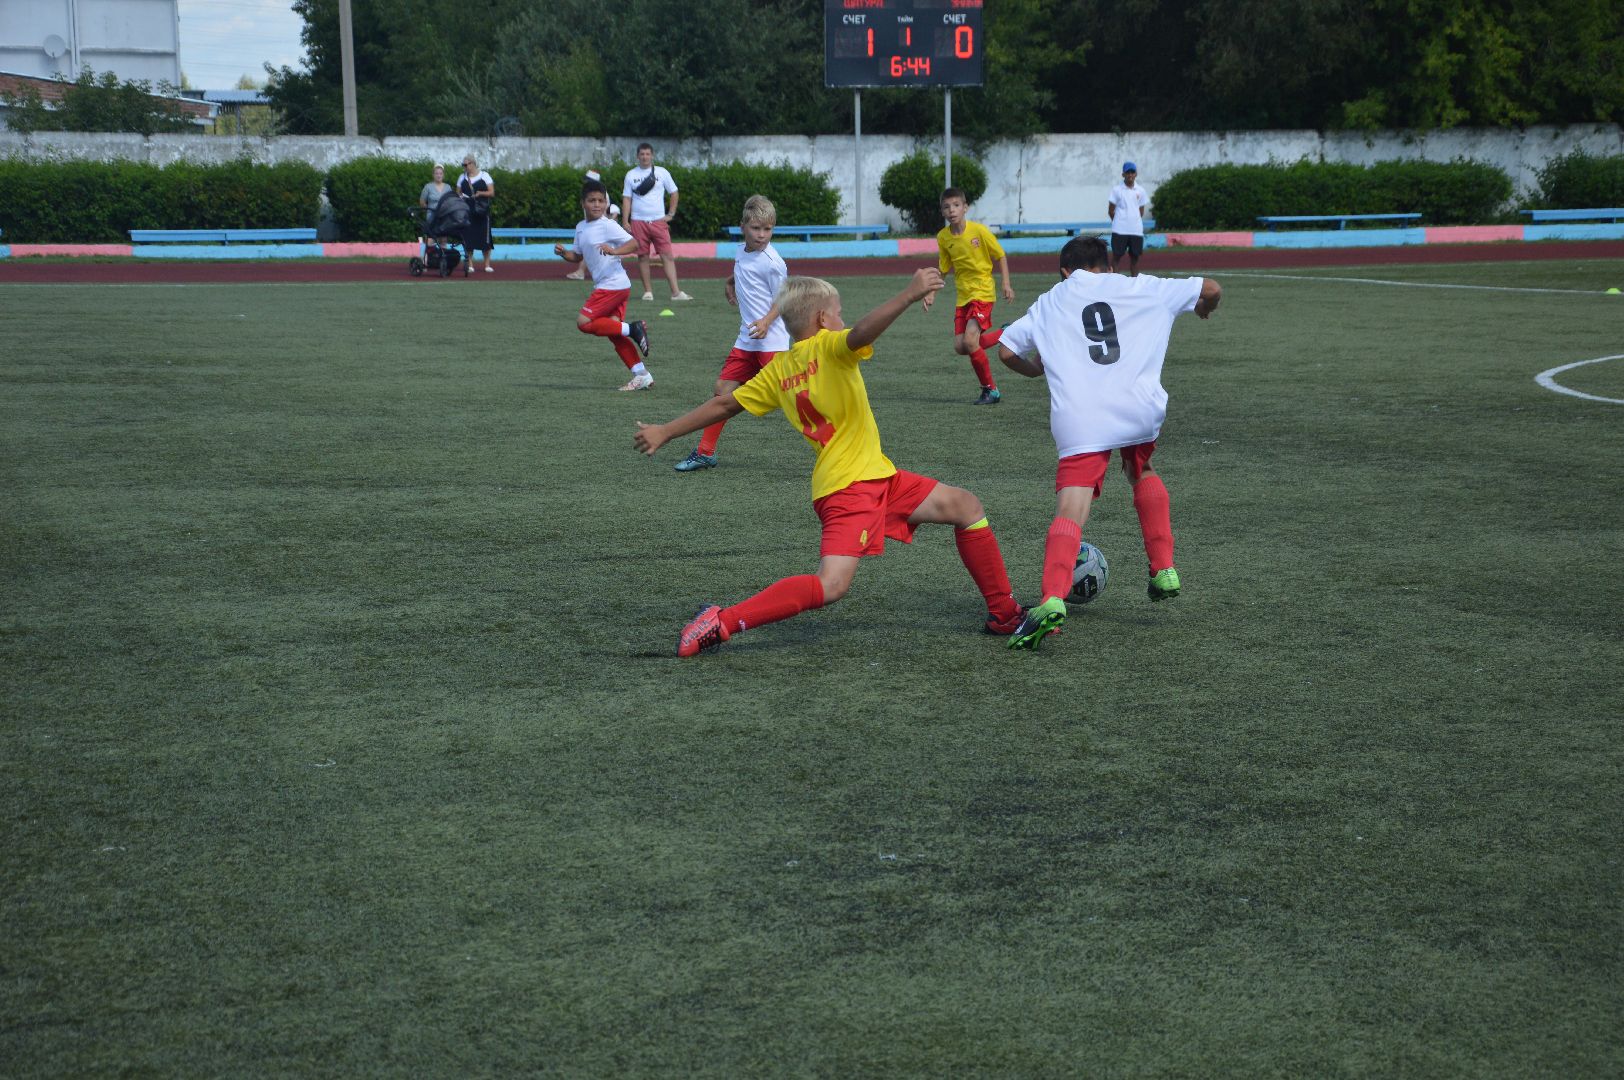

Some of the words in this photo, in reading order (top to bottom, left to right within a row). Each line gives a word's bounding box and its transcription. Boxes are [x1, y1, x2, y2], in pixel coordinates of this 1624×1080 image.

[843, 14, 867, 24] СЧЕТ
[943, 13, 967, 24] СЧЕТ
[867, 27, 874, 57] 1
[906, 26, 911, 46] 1
[955, 25, 974, 59] 0
[890, 55, 931, 77] 6:44
[1081, 301, 1121, 365] 9
[796, 389, 837, 448] 4
